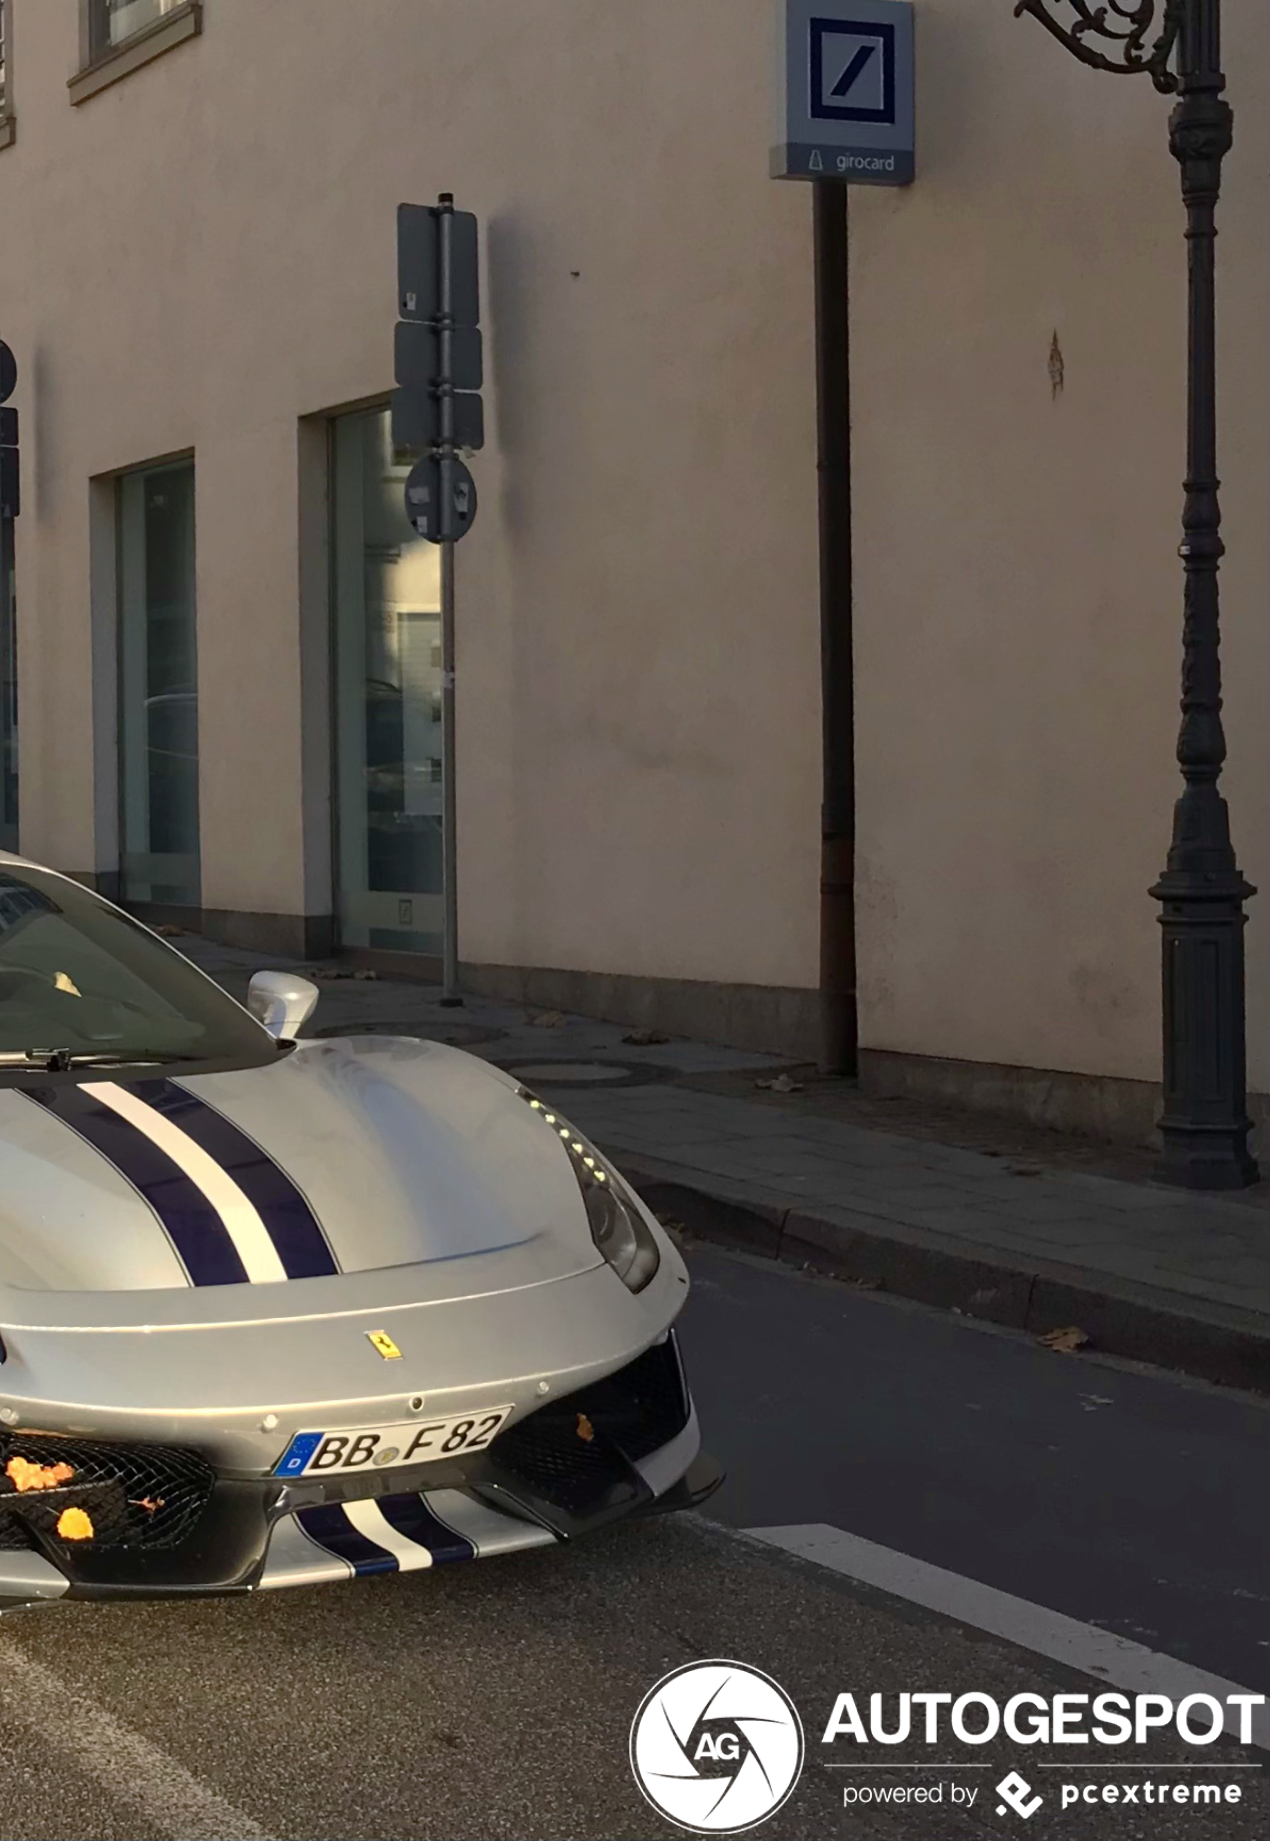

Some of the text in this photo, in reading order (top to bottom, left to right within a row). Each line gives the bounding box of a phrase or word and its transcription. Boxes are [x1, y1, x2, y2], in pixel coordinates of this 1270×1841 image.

[836, 152, 895, 172] girocard
[287, 1458, 302, 1468] D
[309, 1433, 381, 1470] BB
